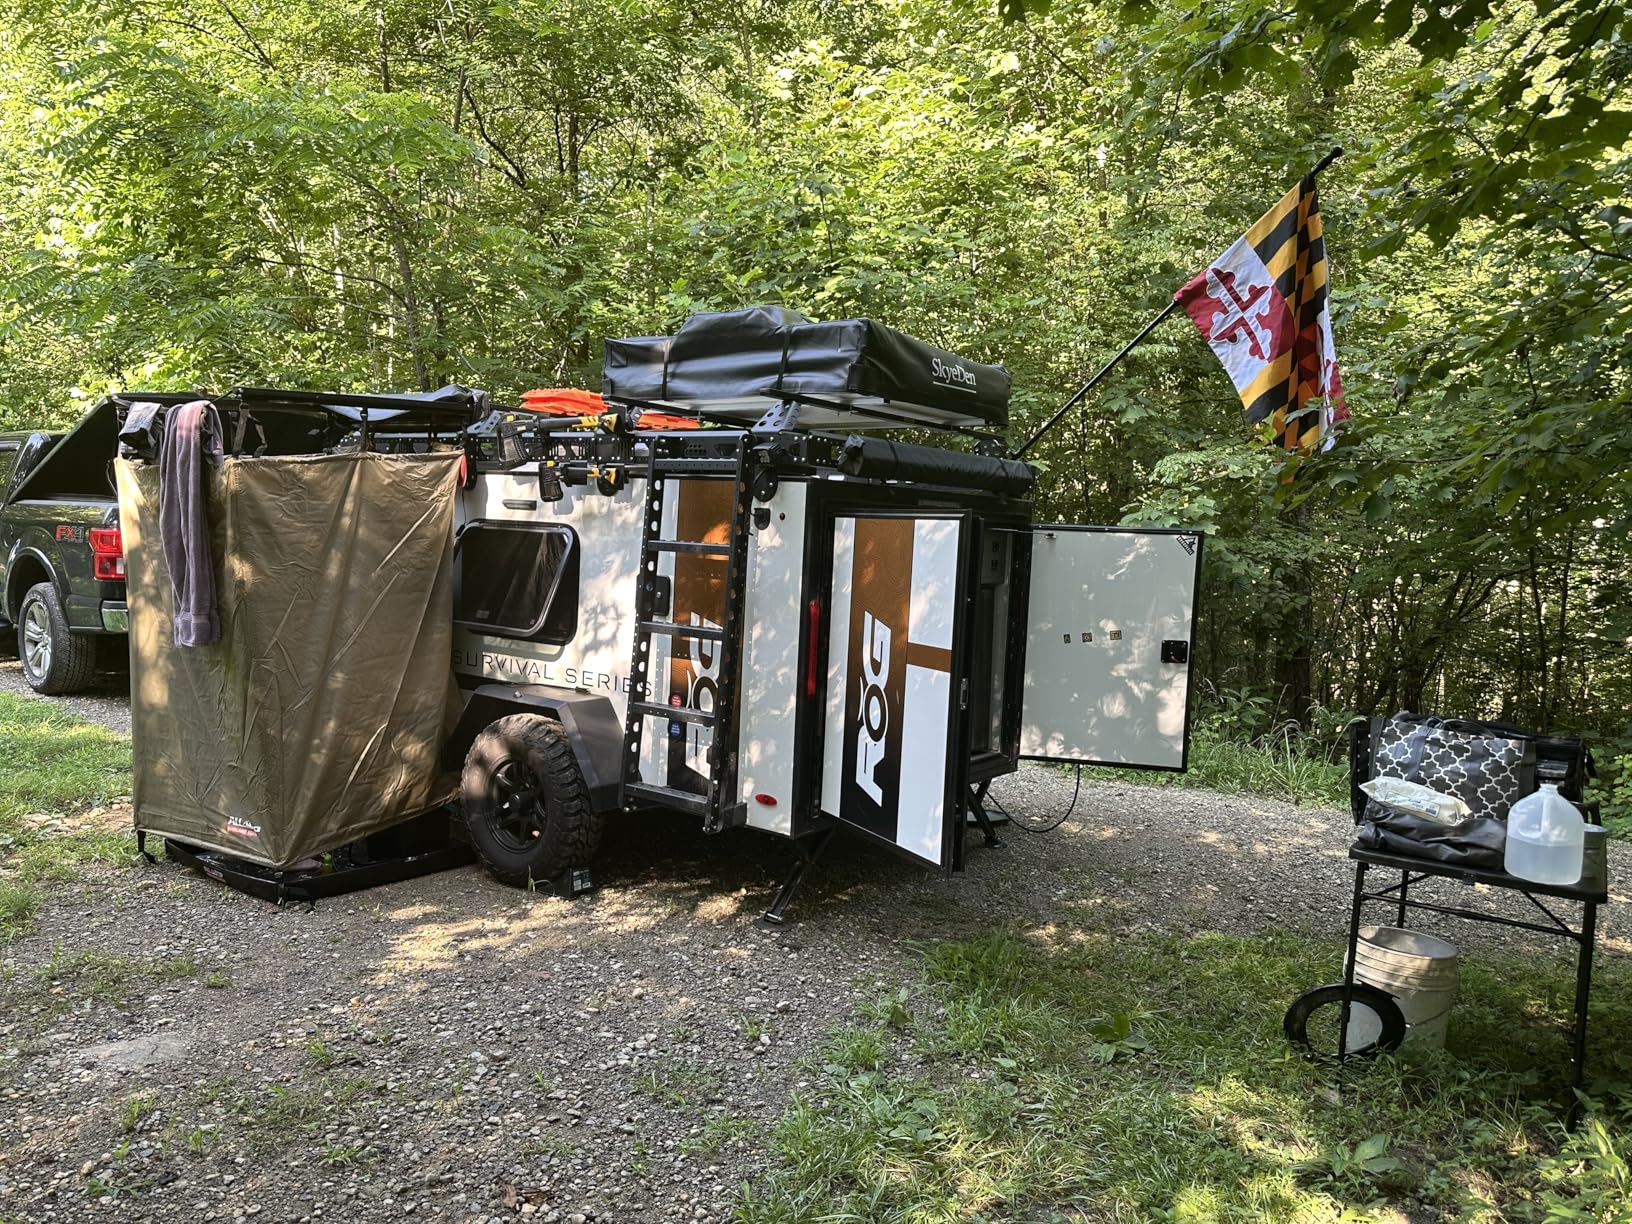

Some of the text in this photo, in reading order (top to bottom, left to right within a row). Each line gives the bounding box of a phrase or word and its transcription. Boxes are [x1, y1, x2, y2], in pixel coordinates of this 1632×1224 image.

[931, 357, 977, 386] SkyeDen
[55, 525, 84, 543] FX4
[452, 650, 555, 681] SURVIVAL
[855, 610, 892, 808] ROG
